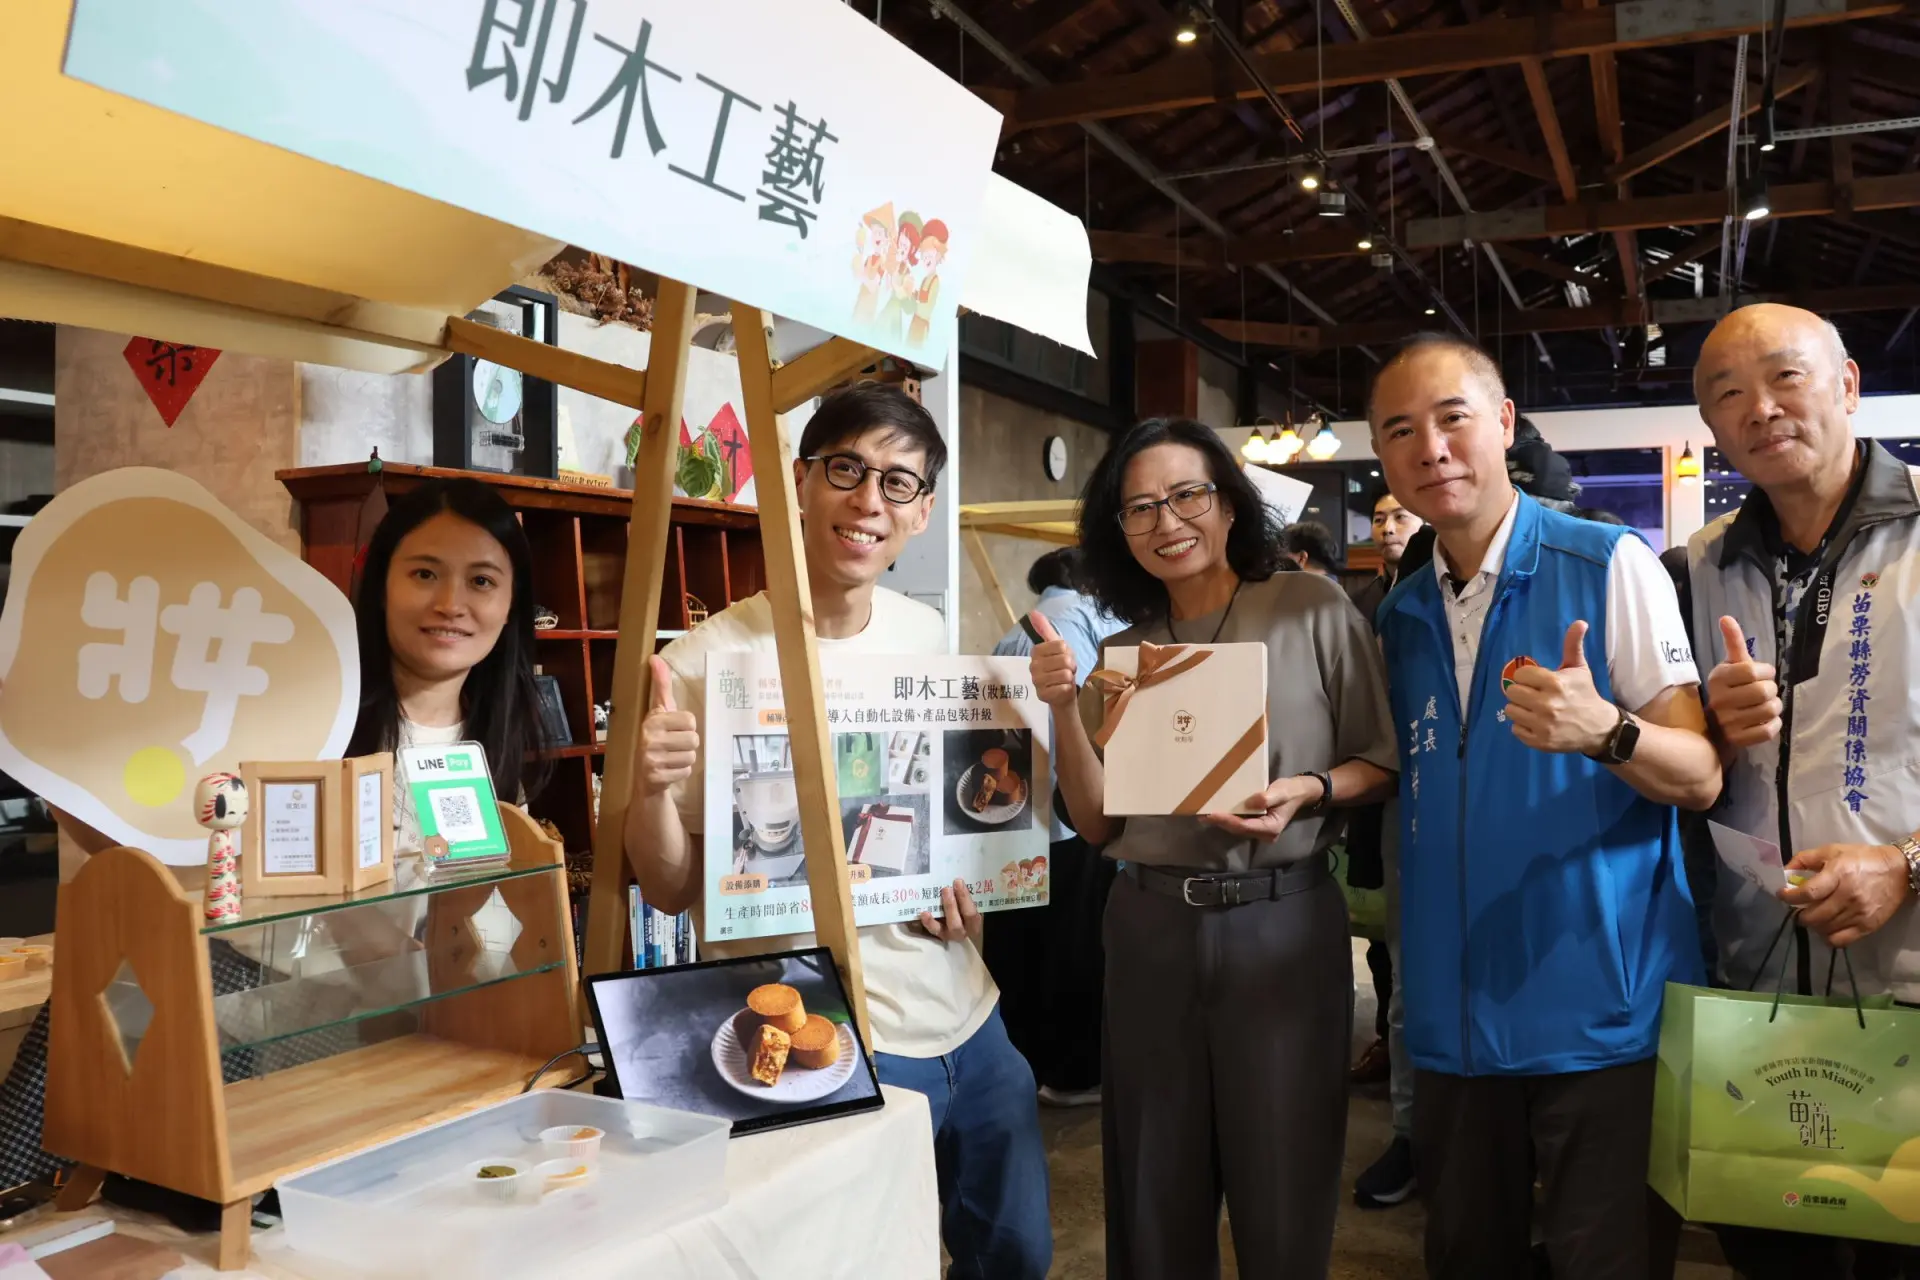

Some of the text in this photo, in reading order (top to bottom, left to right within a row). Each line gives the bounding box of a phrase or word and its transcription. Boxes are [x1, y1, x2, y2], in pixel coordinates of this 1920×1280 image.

[465, 0, 839, 240] 即木工藝
[1843, 592, 1873, 812] 苗栗縣勞資關係協會
[828, 708, 993, 724] 導入自動化設備、產品包裝升級
[417, 758, 445, 770] LINE
[725, 879, 761, 891] 設備添購
[724, 899, 812, 920] 生產時間節省8
[1765, 1067, 1864, 1095] Youth In Miaoli
